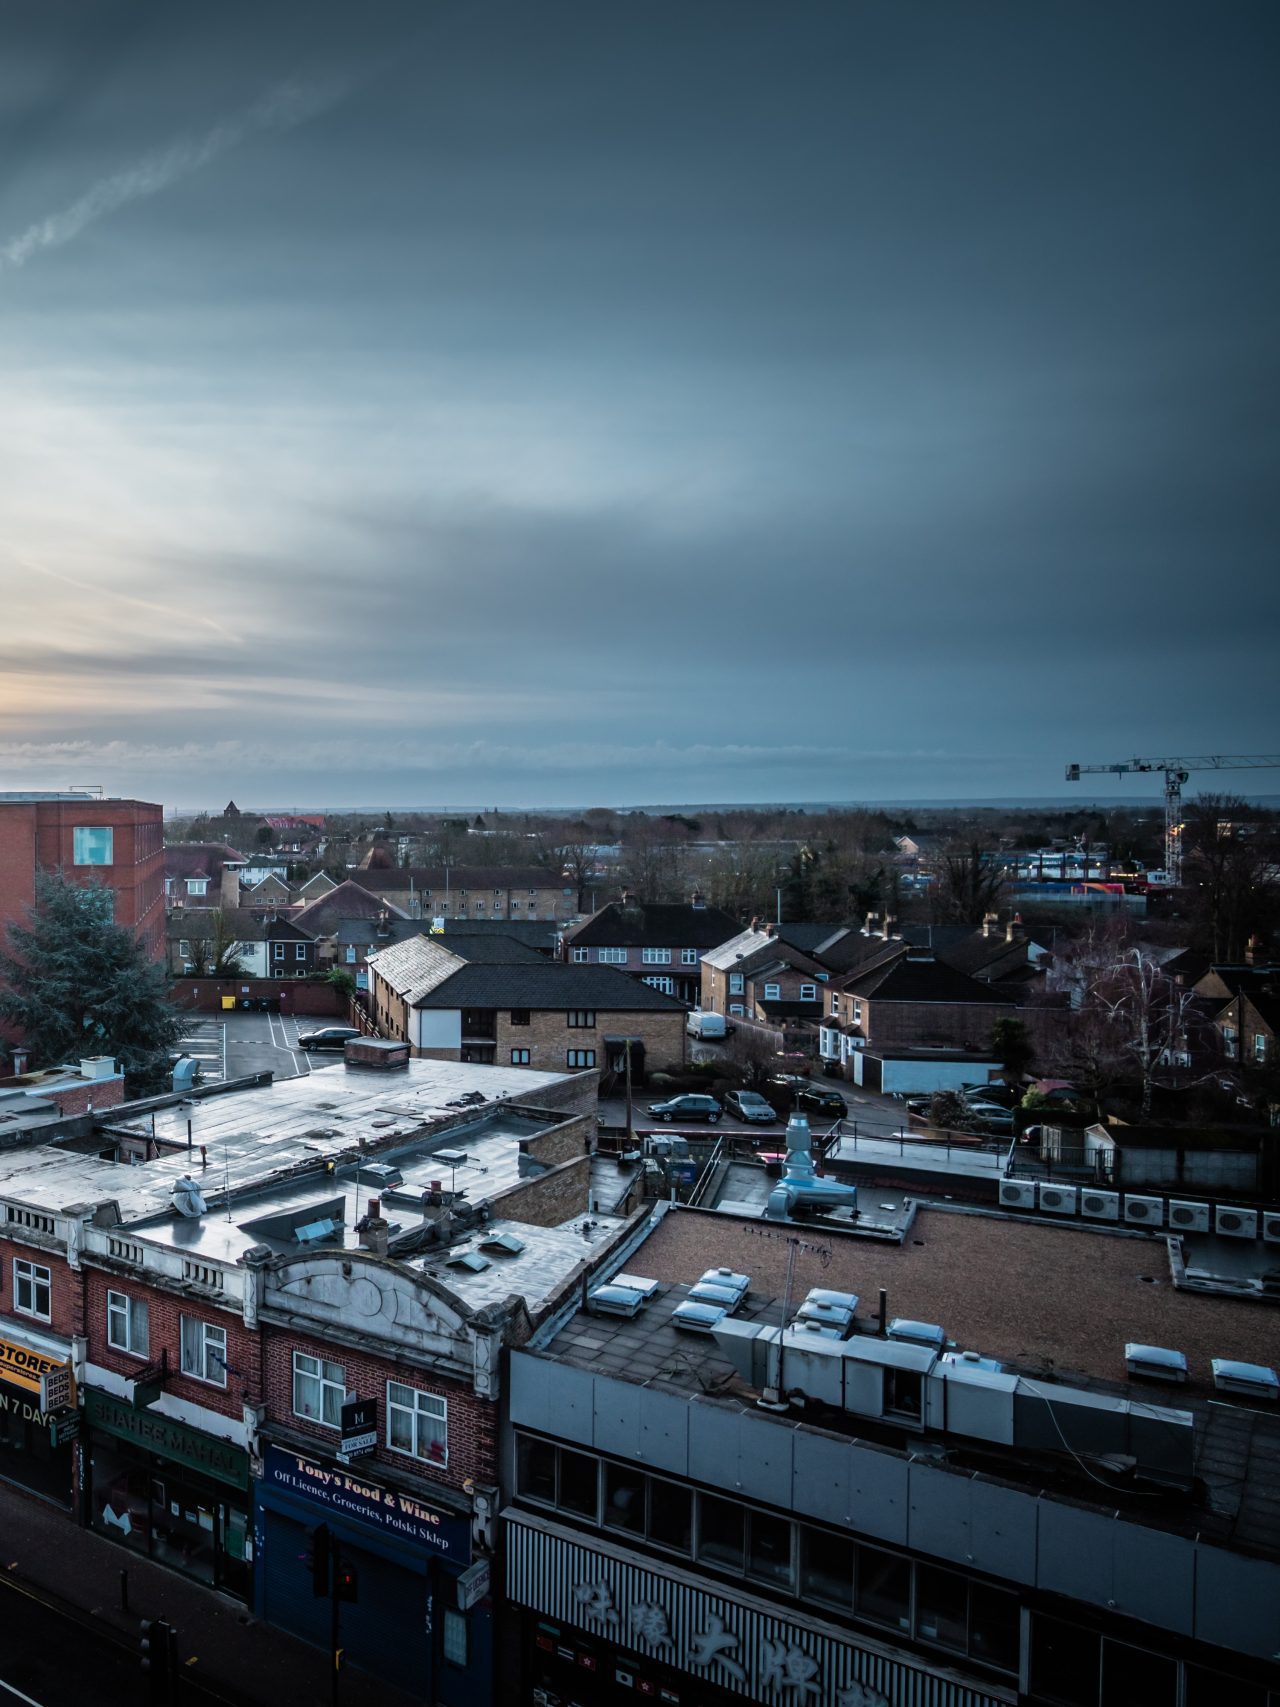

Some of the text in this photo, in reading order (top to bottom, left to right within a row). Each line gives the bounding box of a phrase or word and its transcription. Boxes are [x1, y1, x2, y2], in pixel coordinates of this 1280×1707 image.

[48, 1371, 69, 1388] BEDS
[48, 1382, 70, 1399] BEDS
[12, 1399, 21, 1415] 7
[48, 1392, 70, 1409] BEDS
[354, 1411, 364, 1424] M
[94, 1403, 166, 1444] SHAHEE
[169, 1434, 241, 1476] MAHAL
[296, 1457, 342, 1486] Tony's
[344, 1477, 380, 1502] Food
[384, 1493, 396, 1508] &
[399, 1498, 441, 1526] Wine
[274, 1469, 449, 1550] Off Licence, Groceries, Polski Sklep
